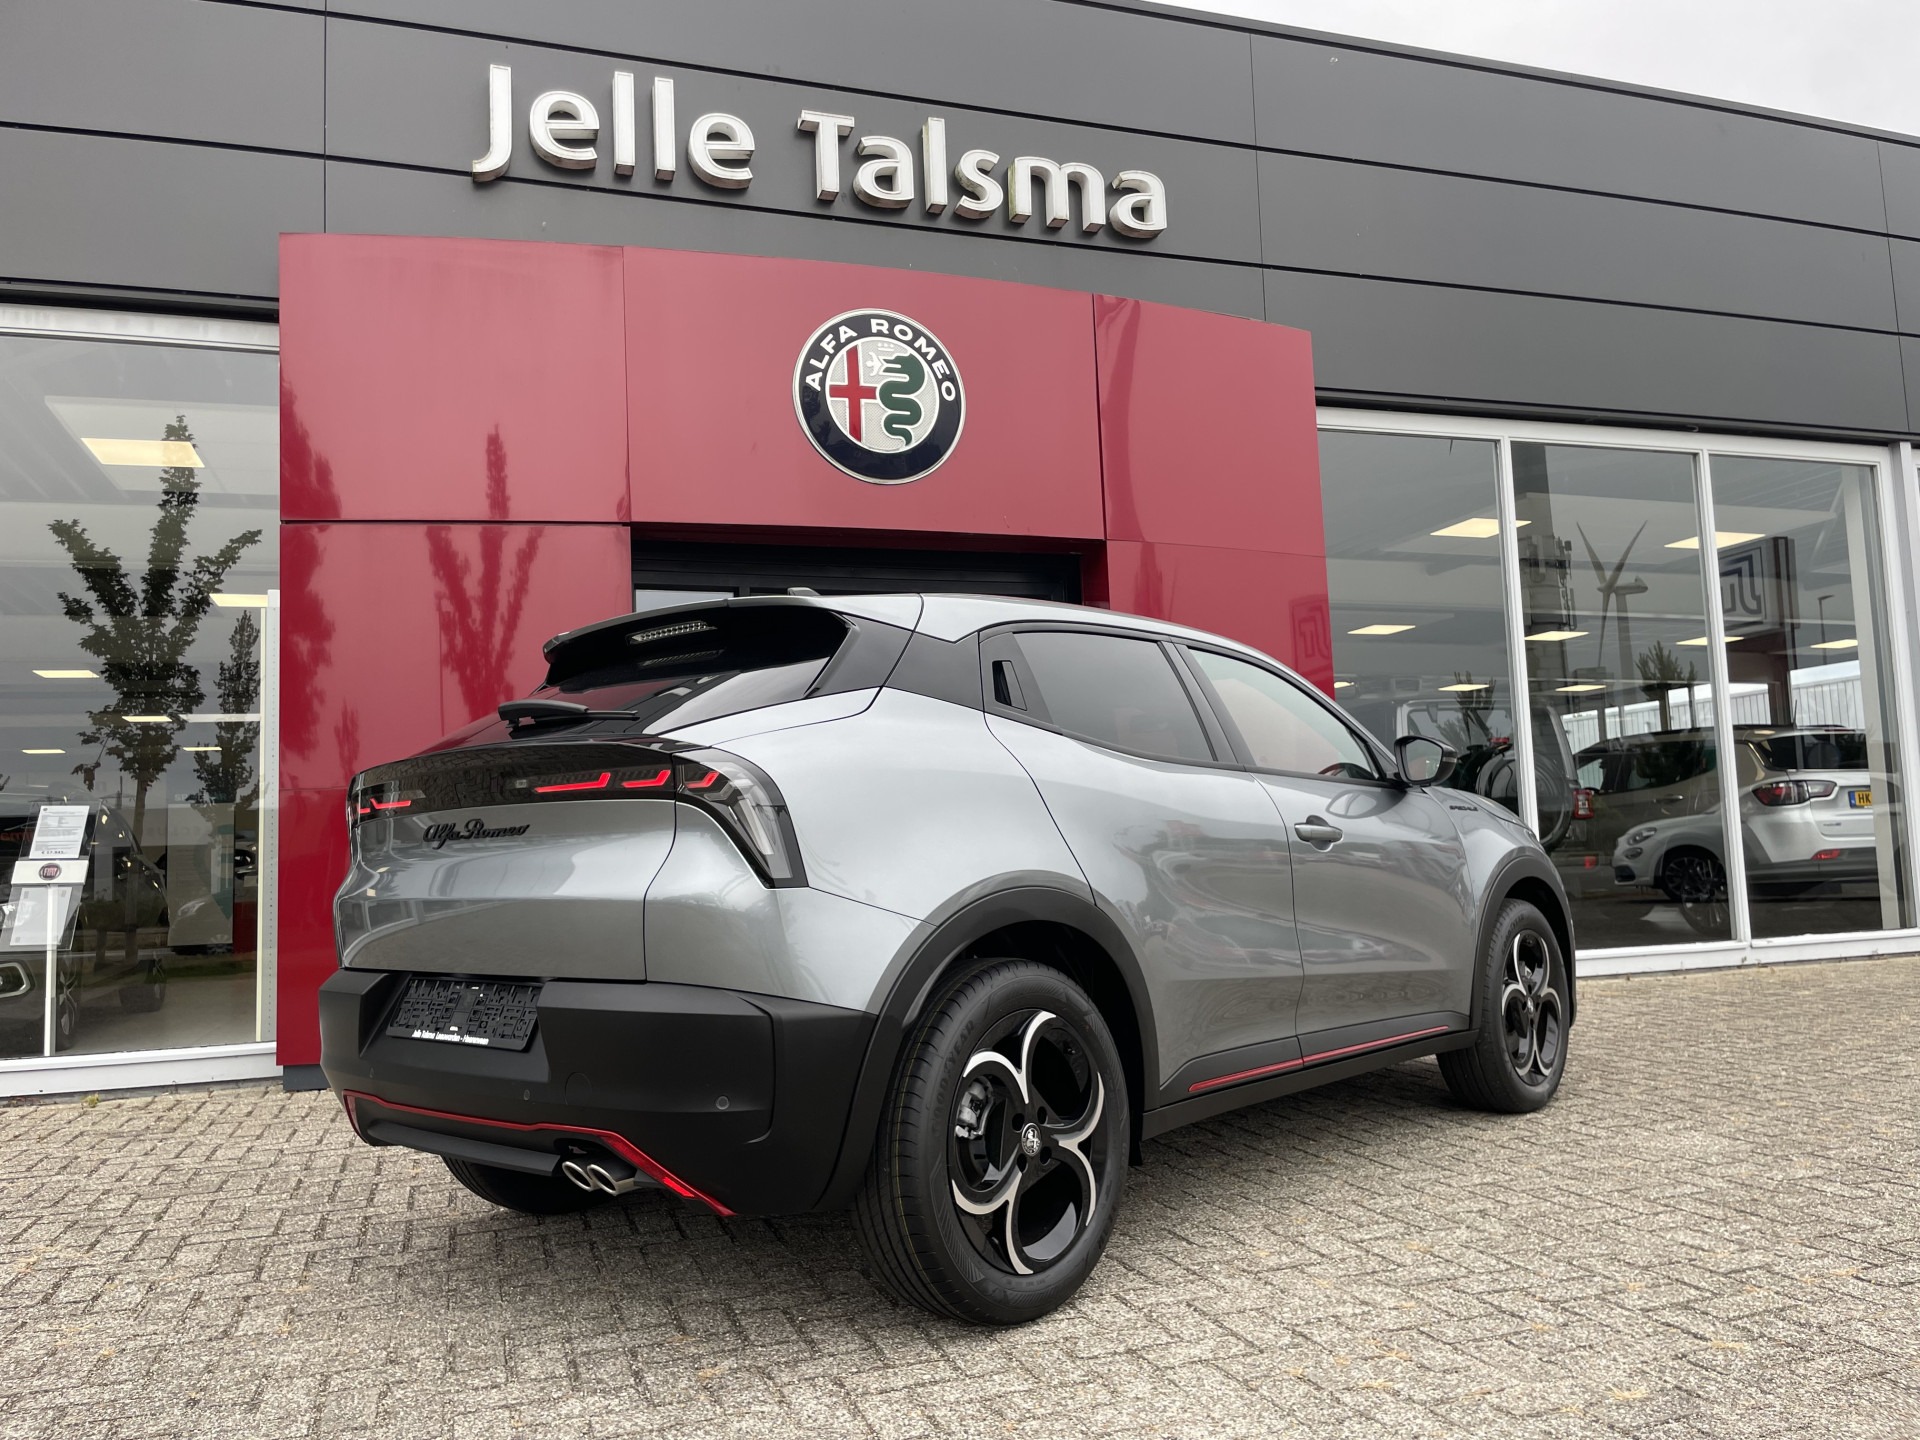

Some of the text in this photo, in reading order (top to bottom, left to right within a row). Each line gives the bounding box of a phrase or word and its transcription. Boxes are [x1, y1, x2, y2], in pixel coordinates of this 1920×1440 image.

[472, 64, 1168, 239] Jelle Talsma
[806, 318, 956, 401] ALFA ROMEO
[423, 818, 531, 850] Alfa Romeo
